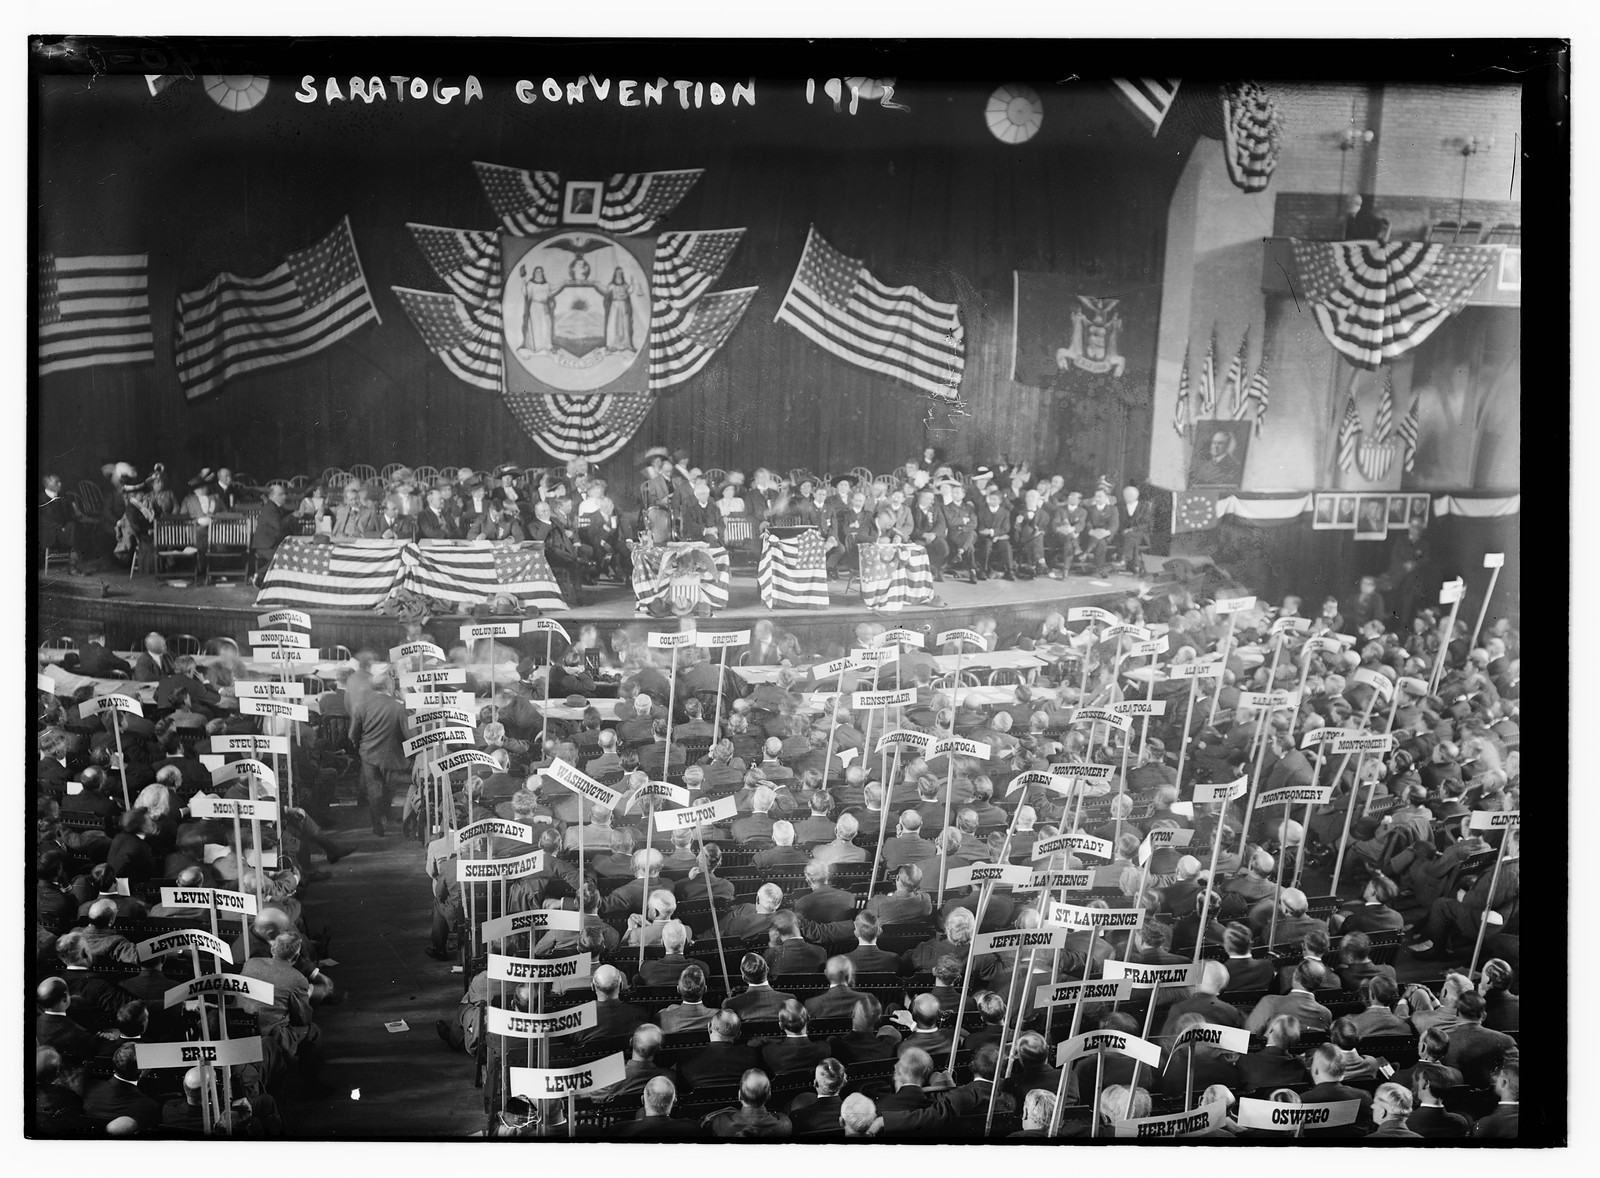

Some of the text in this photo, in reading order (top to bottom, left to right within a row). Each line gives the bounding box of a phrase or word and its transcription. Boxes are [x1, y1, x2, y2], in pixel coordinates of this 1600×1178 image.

[268, 612, 303, 623] ONONDAGA
[260, 633, 299, 644] ONONDAGA
[712, 634, 738, 644] GREENE
[829, 659, 858, 673] ALBAN
[416, 672, 449, 683] ALBANY
[253, 685, 286, 695] CAYUGA
[97, 697, 130, 709] WAYNE
[423, 695, 458, 705] ALBANY
[860, 693, 911, 706] RENSSELAER
[255, 703, 293, 716] STEUBEN
[1114, 703, 1152, 714] SARATOGA
[415, 710, 469, 724] RENSSELAER
[1075, 710, 1123, 725] RENSSELAER
[229, 738, 271, 749] STEUBEN
[410, 730, 467, 751] RENSSELAER
[934, 741, 977, 754] SARATOGA
[1338, 738, 1388, 750] MONTGOMERY
[235, 763, 262, 775] TIOGA
[437, 752, 495, 772] WASHINGTON
[1052, 765, 1110, 778] MONTGOMERY
[556, 765, 614, 805] WASHINGTON
[1016, 773, 1053, 787] WARREN
[634, 785, 673, 800] WARREN
[1261, 789, 1324, 804] MONTGOMERY
[213, 802, 255, 815] MONROE
[677, 806, 716, 825] FULTON
[459, 821, 525, 843] SCHENECTADY
[1038, 838, 1104, 855] SCHENECTADY
[465, 856, 538, 877] SCHENECTADY
[970, 867, 1004, 881] ESSEX
[511, 913, 549, 931] ESSEX
[1055, 908, 1138, 927] ST. LAWRENCE
[149, 933, 223, 954] LEVINGSTON
[506, 960, 577, 978] JEFFERSON
[1124, 967, 1188, 985] FRANKLIN
[188, 977, 250, 995] NIAGARA
[1052, 983, 1119, 1001] JEFFERSON
[507, 1011, 582, 1033] JEFFERSON
[1083, 1034, 1127, 1051] LEWIS
[1175, 1028, 1222, 1045] ADISON
[181, 1046, 217, 1062] ERIE
[545, 1070, 593, 1092] LEWIS
[1137, 1111, 1210, 1137] HERKIMER
[1272, 1108, 1330, 1125] OSWEGO
